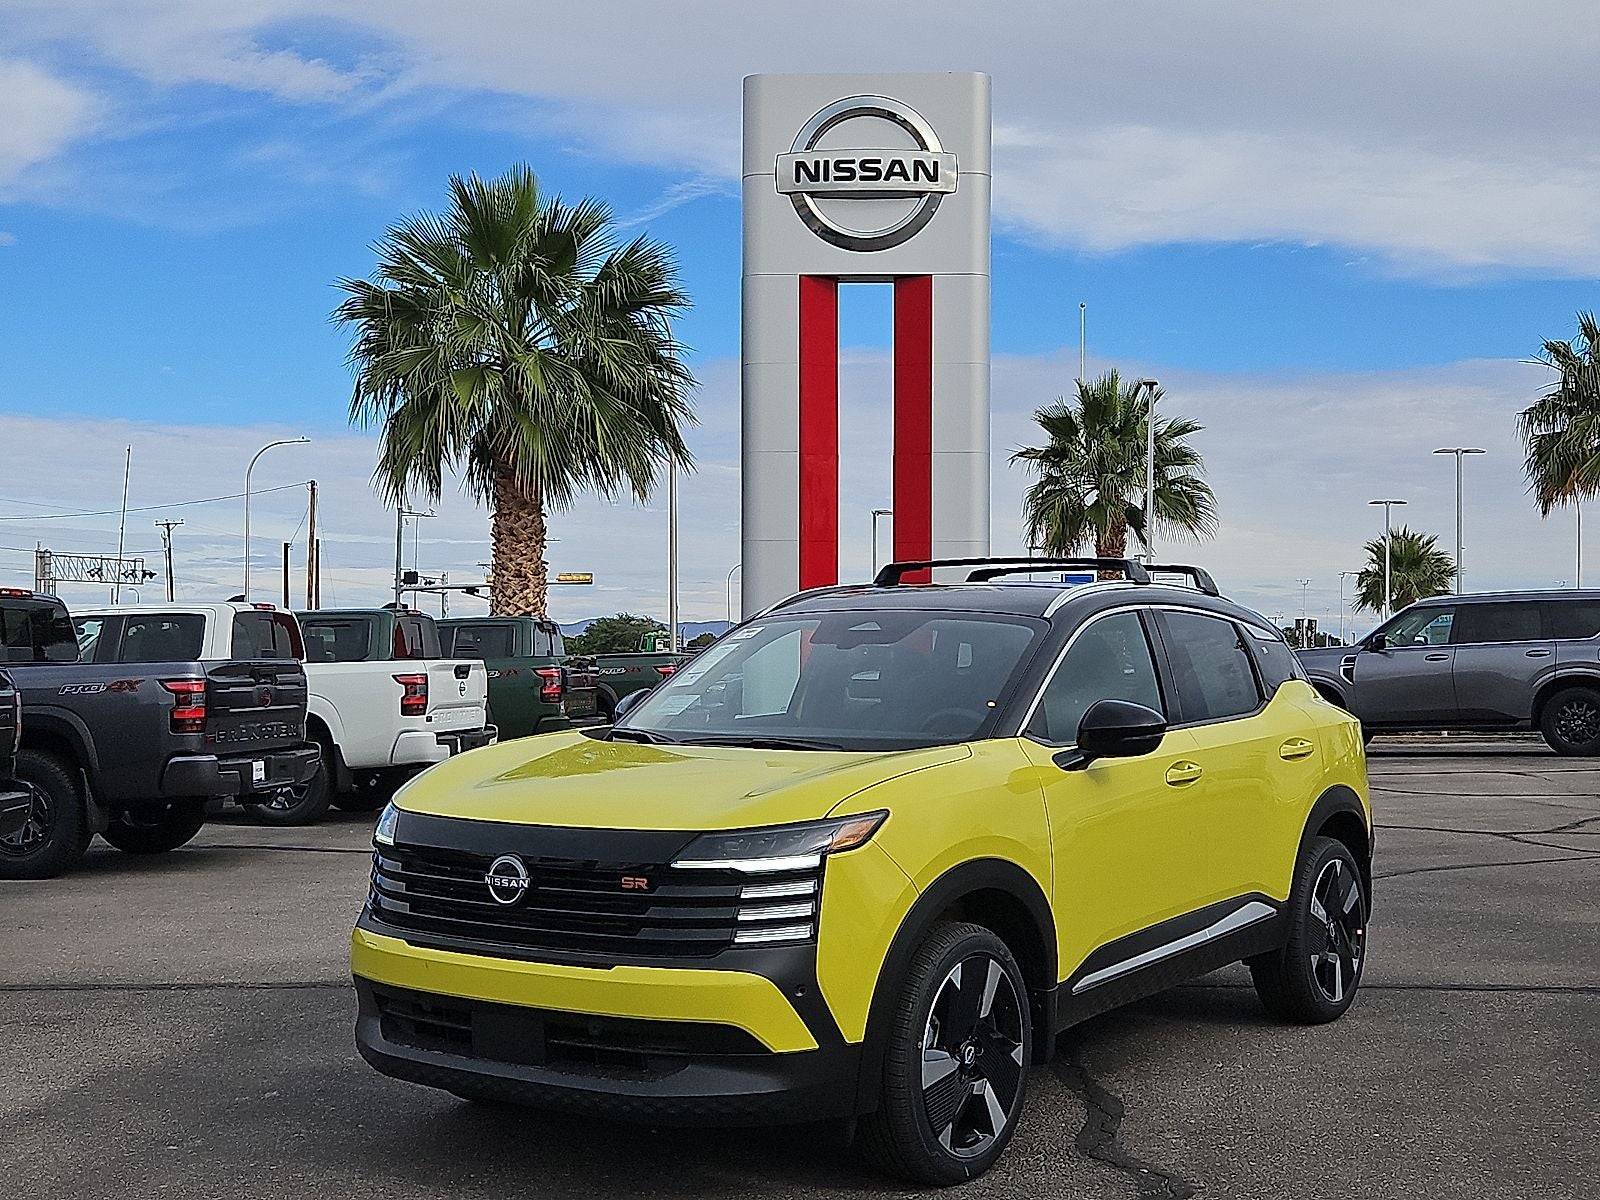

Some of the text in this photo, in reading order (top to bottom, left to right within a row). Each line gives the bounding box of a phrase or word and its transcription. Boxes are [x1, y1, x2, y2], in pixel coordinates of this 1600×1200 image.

[794, 158, 939, 183] NISSAN
[215, 722, 298, 743] FRONTIER
[484, 875, 529, 889] NISSAN
[621, 877, 648, 889] SR
